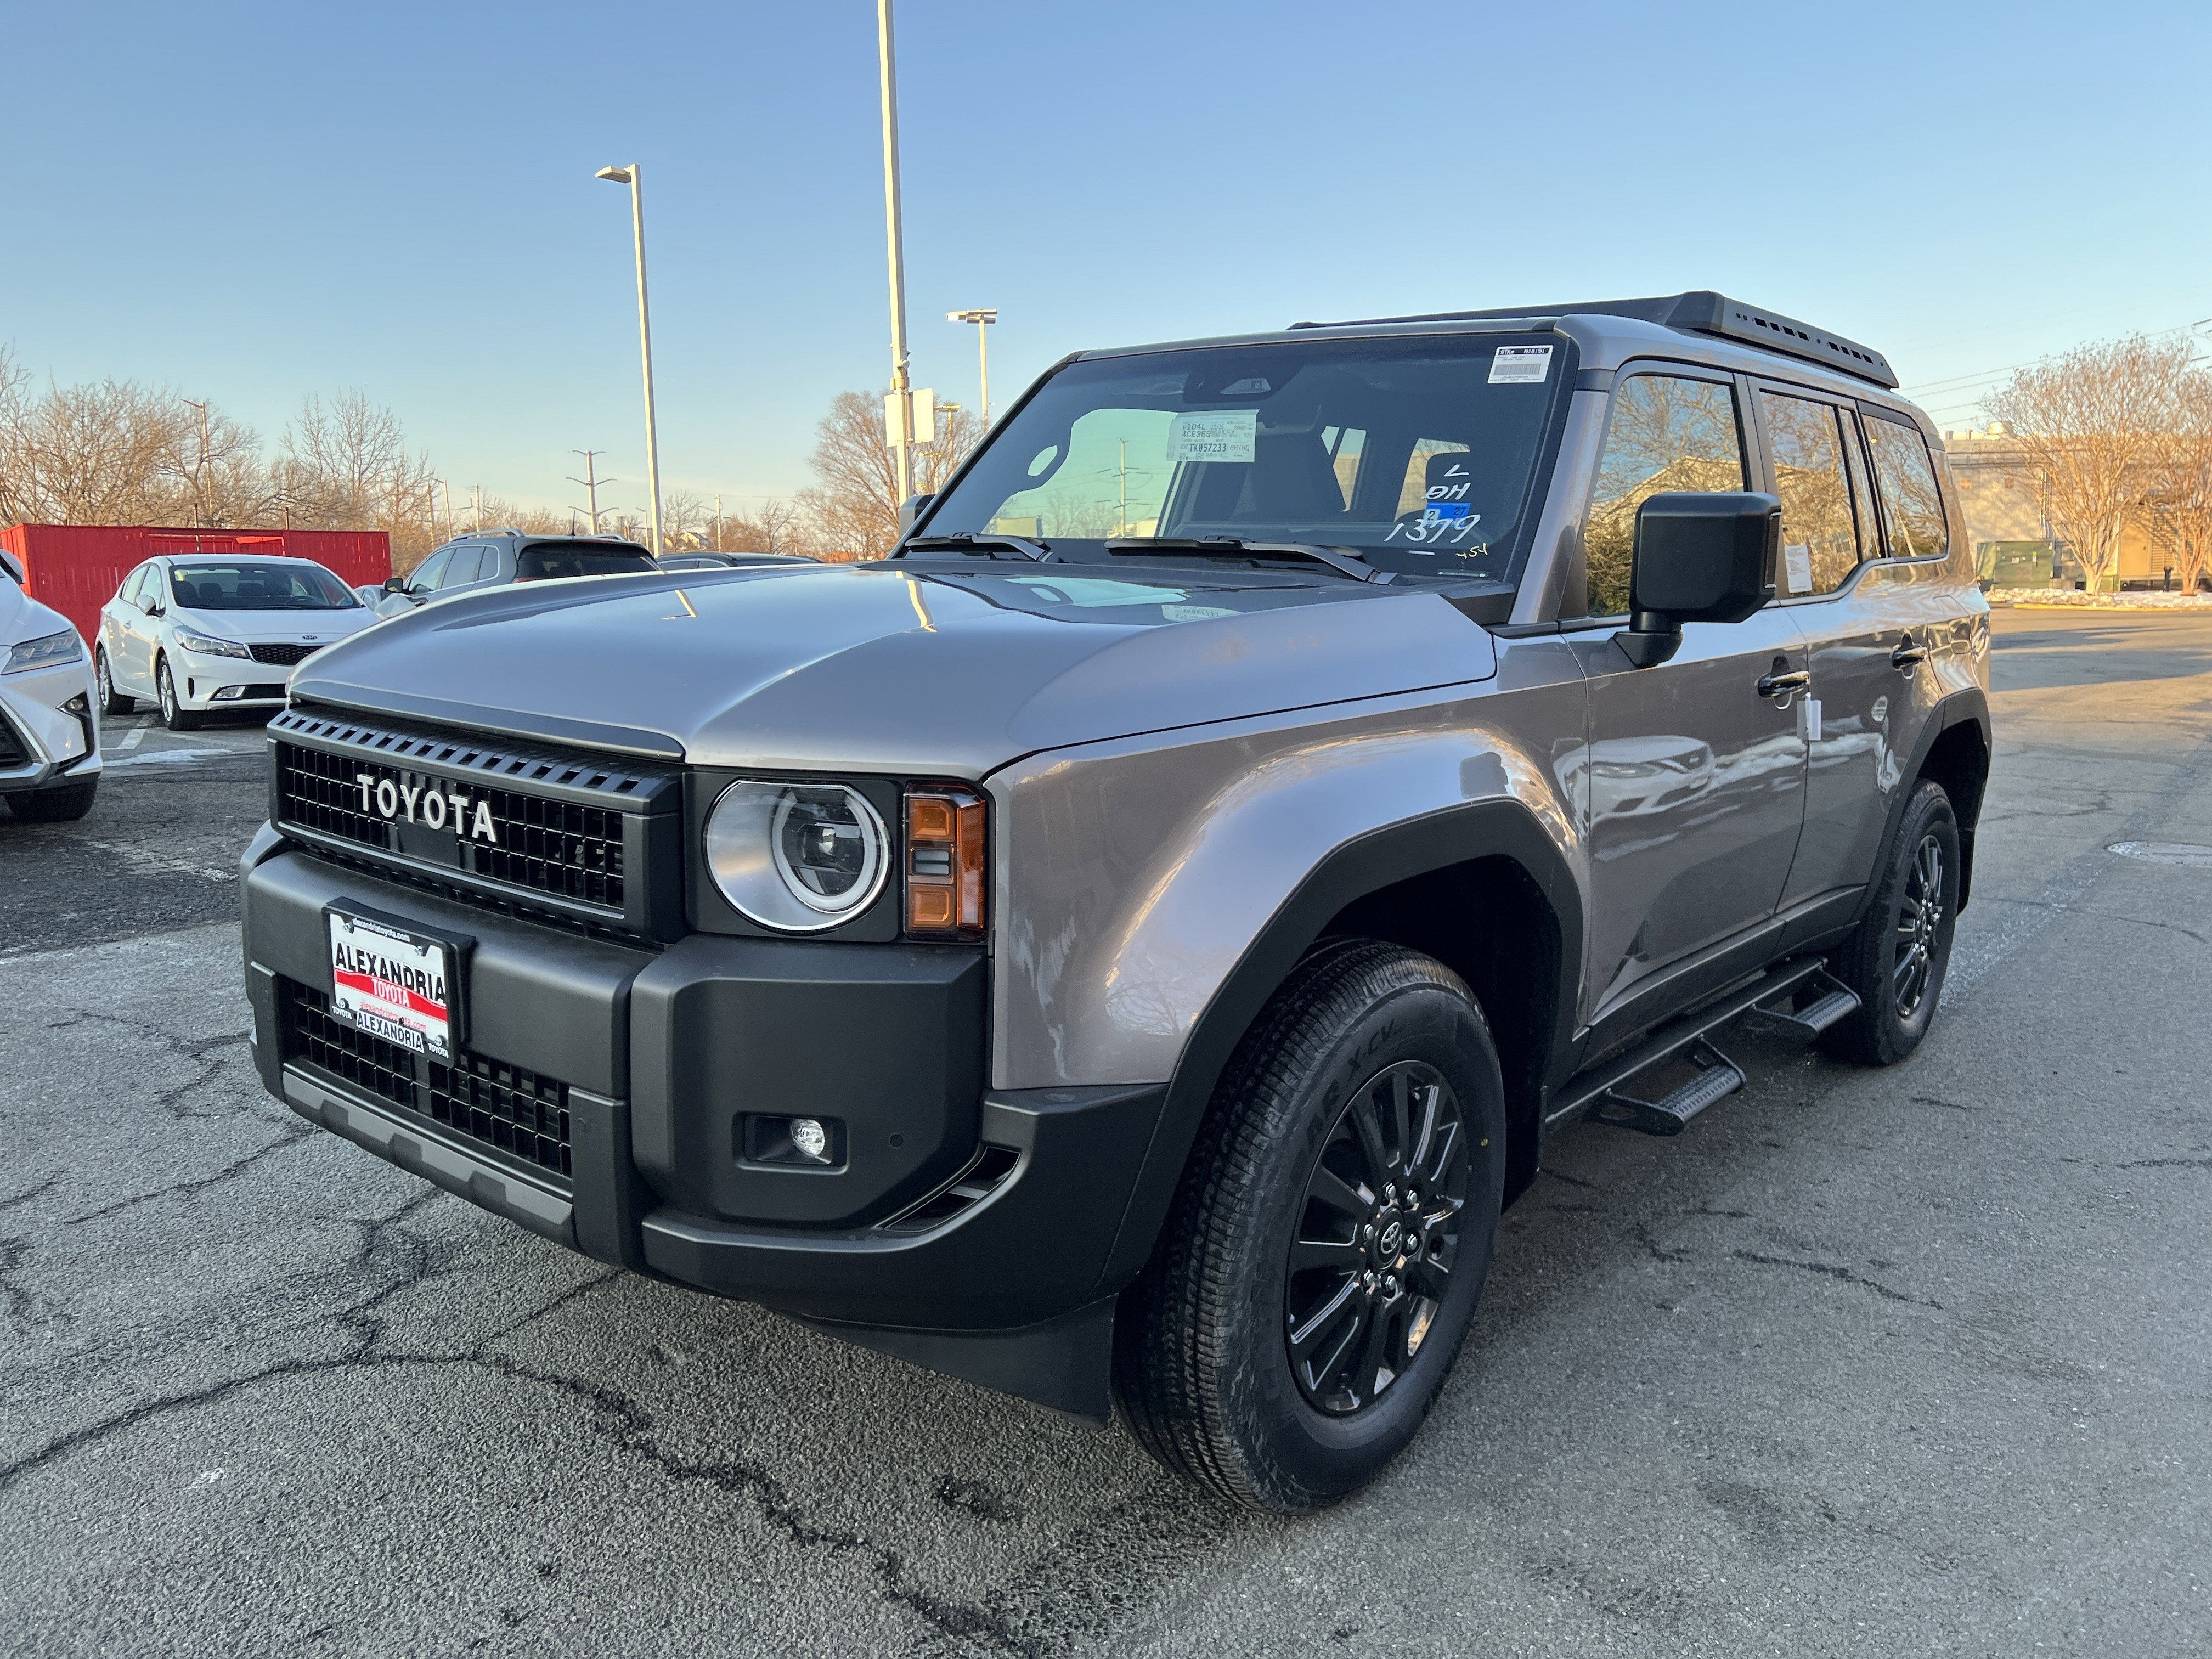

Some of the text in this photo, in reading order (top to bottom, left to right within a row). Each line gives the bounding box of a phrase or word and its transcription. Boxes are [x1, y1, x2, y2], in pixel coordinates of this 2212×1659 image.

[1189, 443, 1227, 452] TK057233
[1427, 511, 1436, 521] 2
[1454, 507, 1466, 516] 27
[1384, 514, 1481, 543] 1379
[357, 774, 496, 842] TOYOTA
[352, 918, 410, 942] alexandriatoyota.com
[336, 943, 446, 1005] ALEXANDRIA
[371, 978, 410, 1007] TOYOTA
[332, 1006, 352, 1019] TOYOTA
[358, 1012, 423, 1052] ALEXANDRIA
[428, 1043, 449, 1058] TOYOTA
